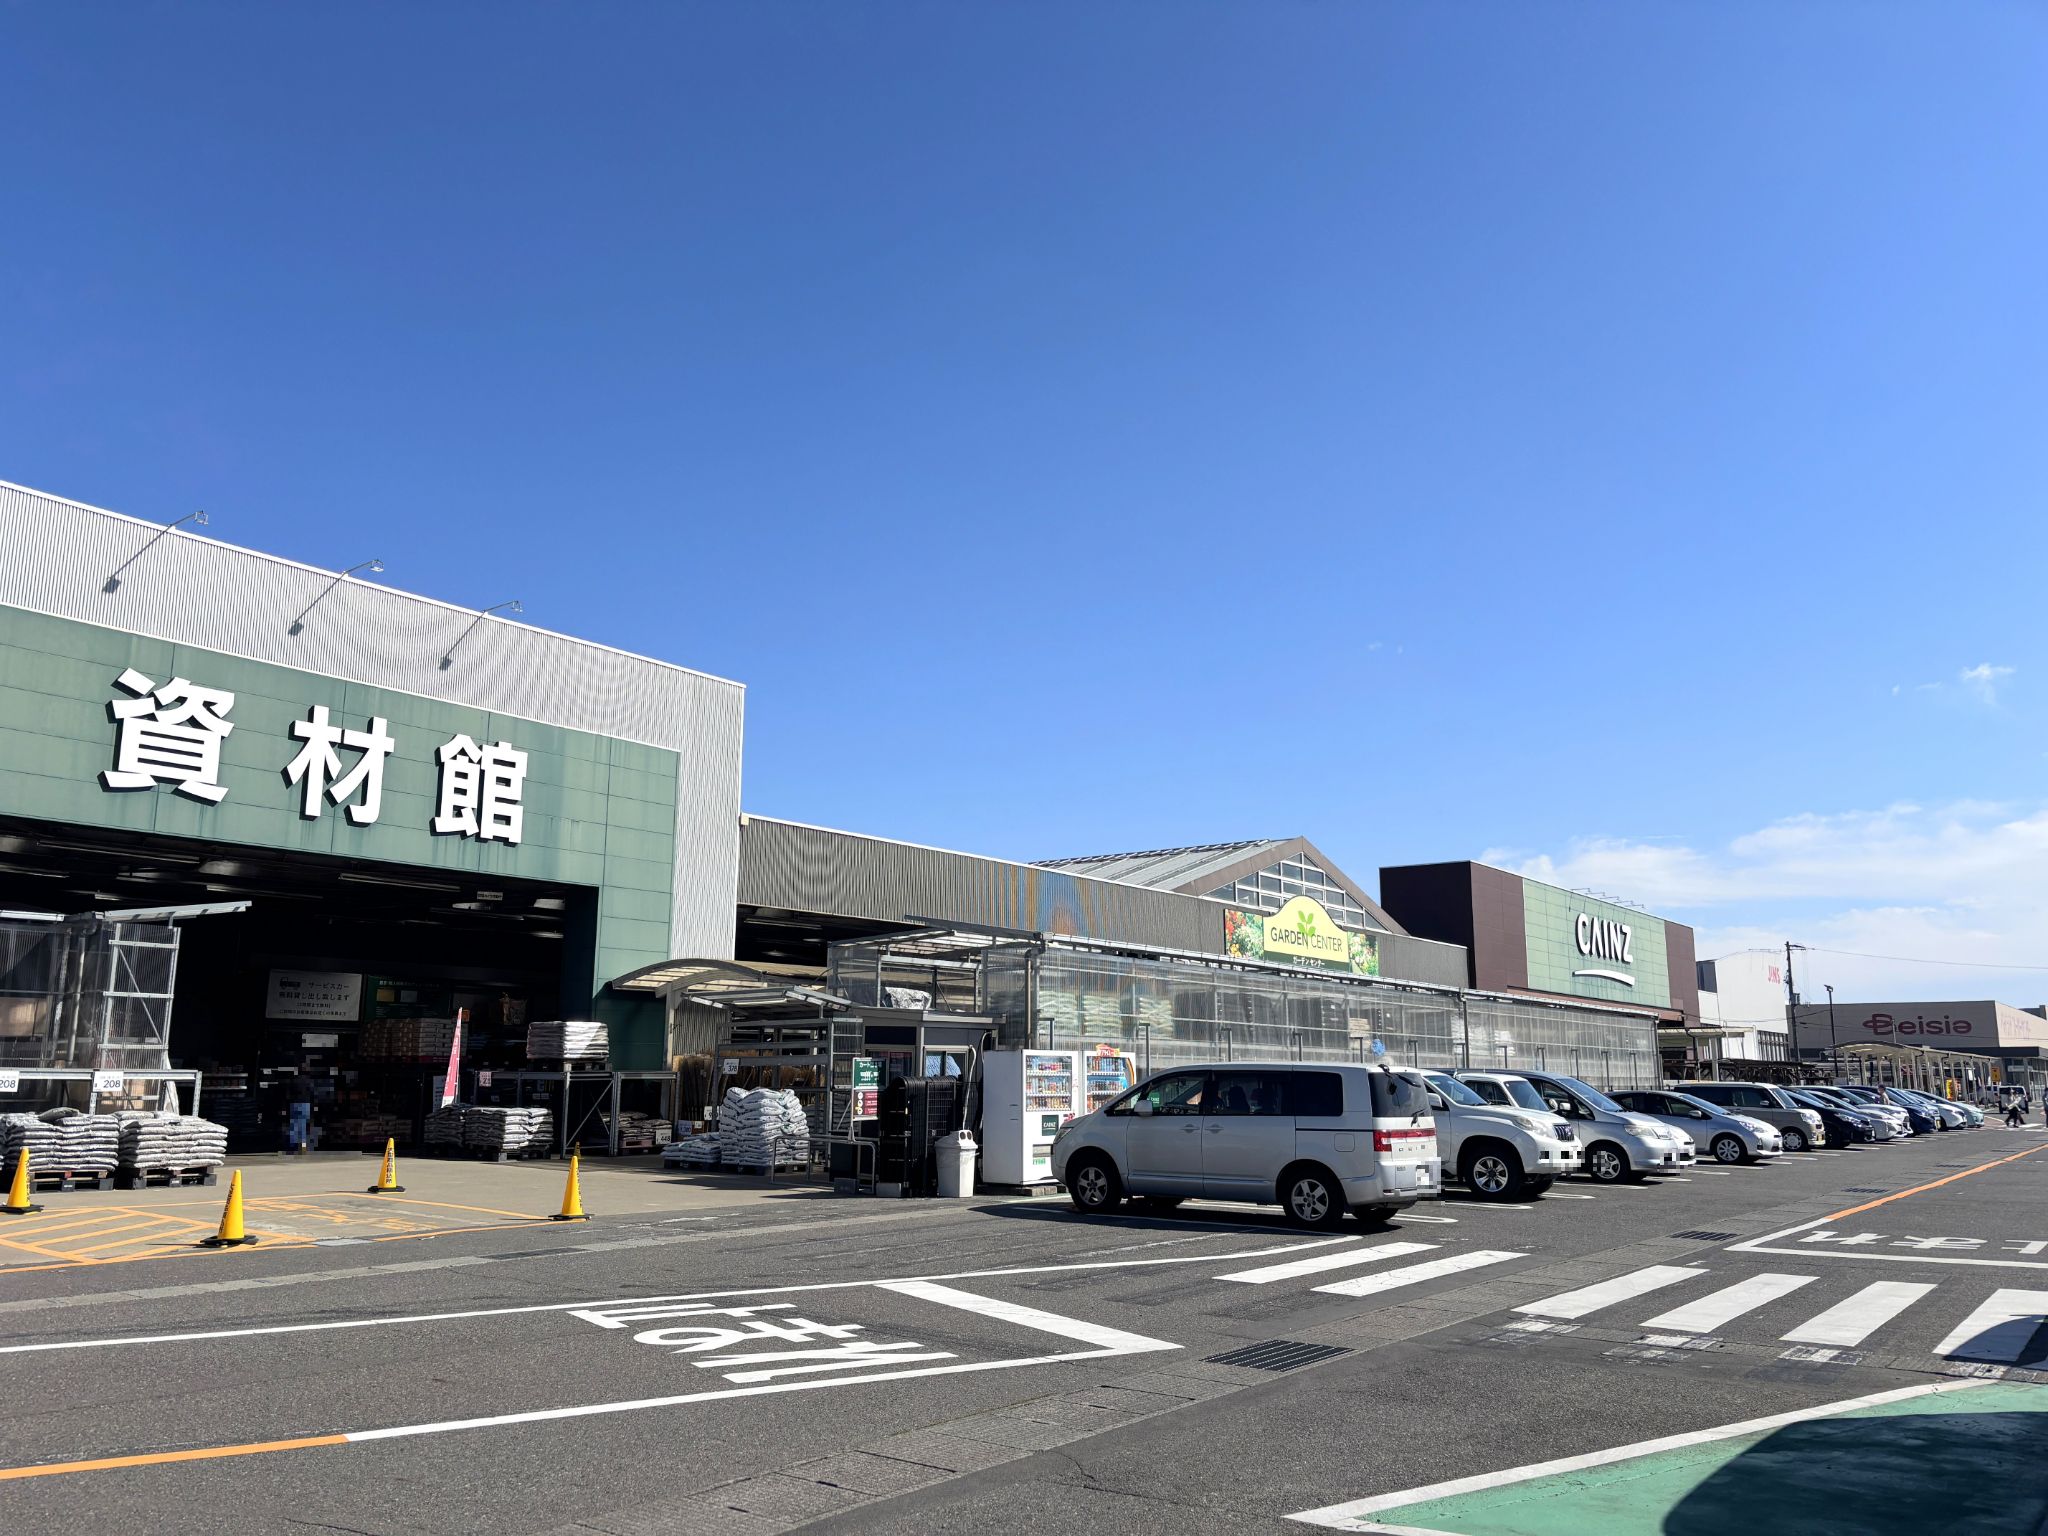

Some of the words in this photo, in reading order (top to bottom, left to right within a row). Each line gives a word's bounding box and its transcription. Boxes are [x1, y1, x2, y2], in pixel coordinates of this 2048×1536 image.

[103, 667, 528, 843] 資材館
[1271, 927, 1308, 949] GARDEN
[1311, 933, 1342, 952] CENTER
[1576, 913, 1633, 963] CAINZ
[308, 981, 350, 990] サービスカー
[1862, 1013, 1972, 1035] Beisia
[103, 1080, 121, 1088] 208
[566, 1303, 959, 1383] 止まれ
